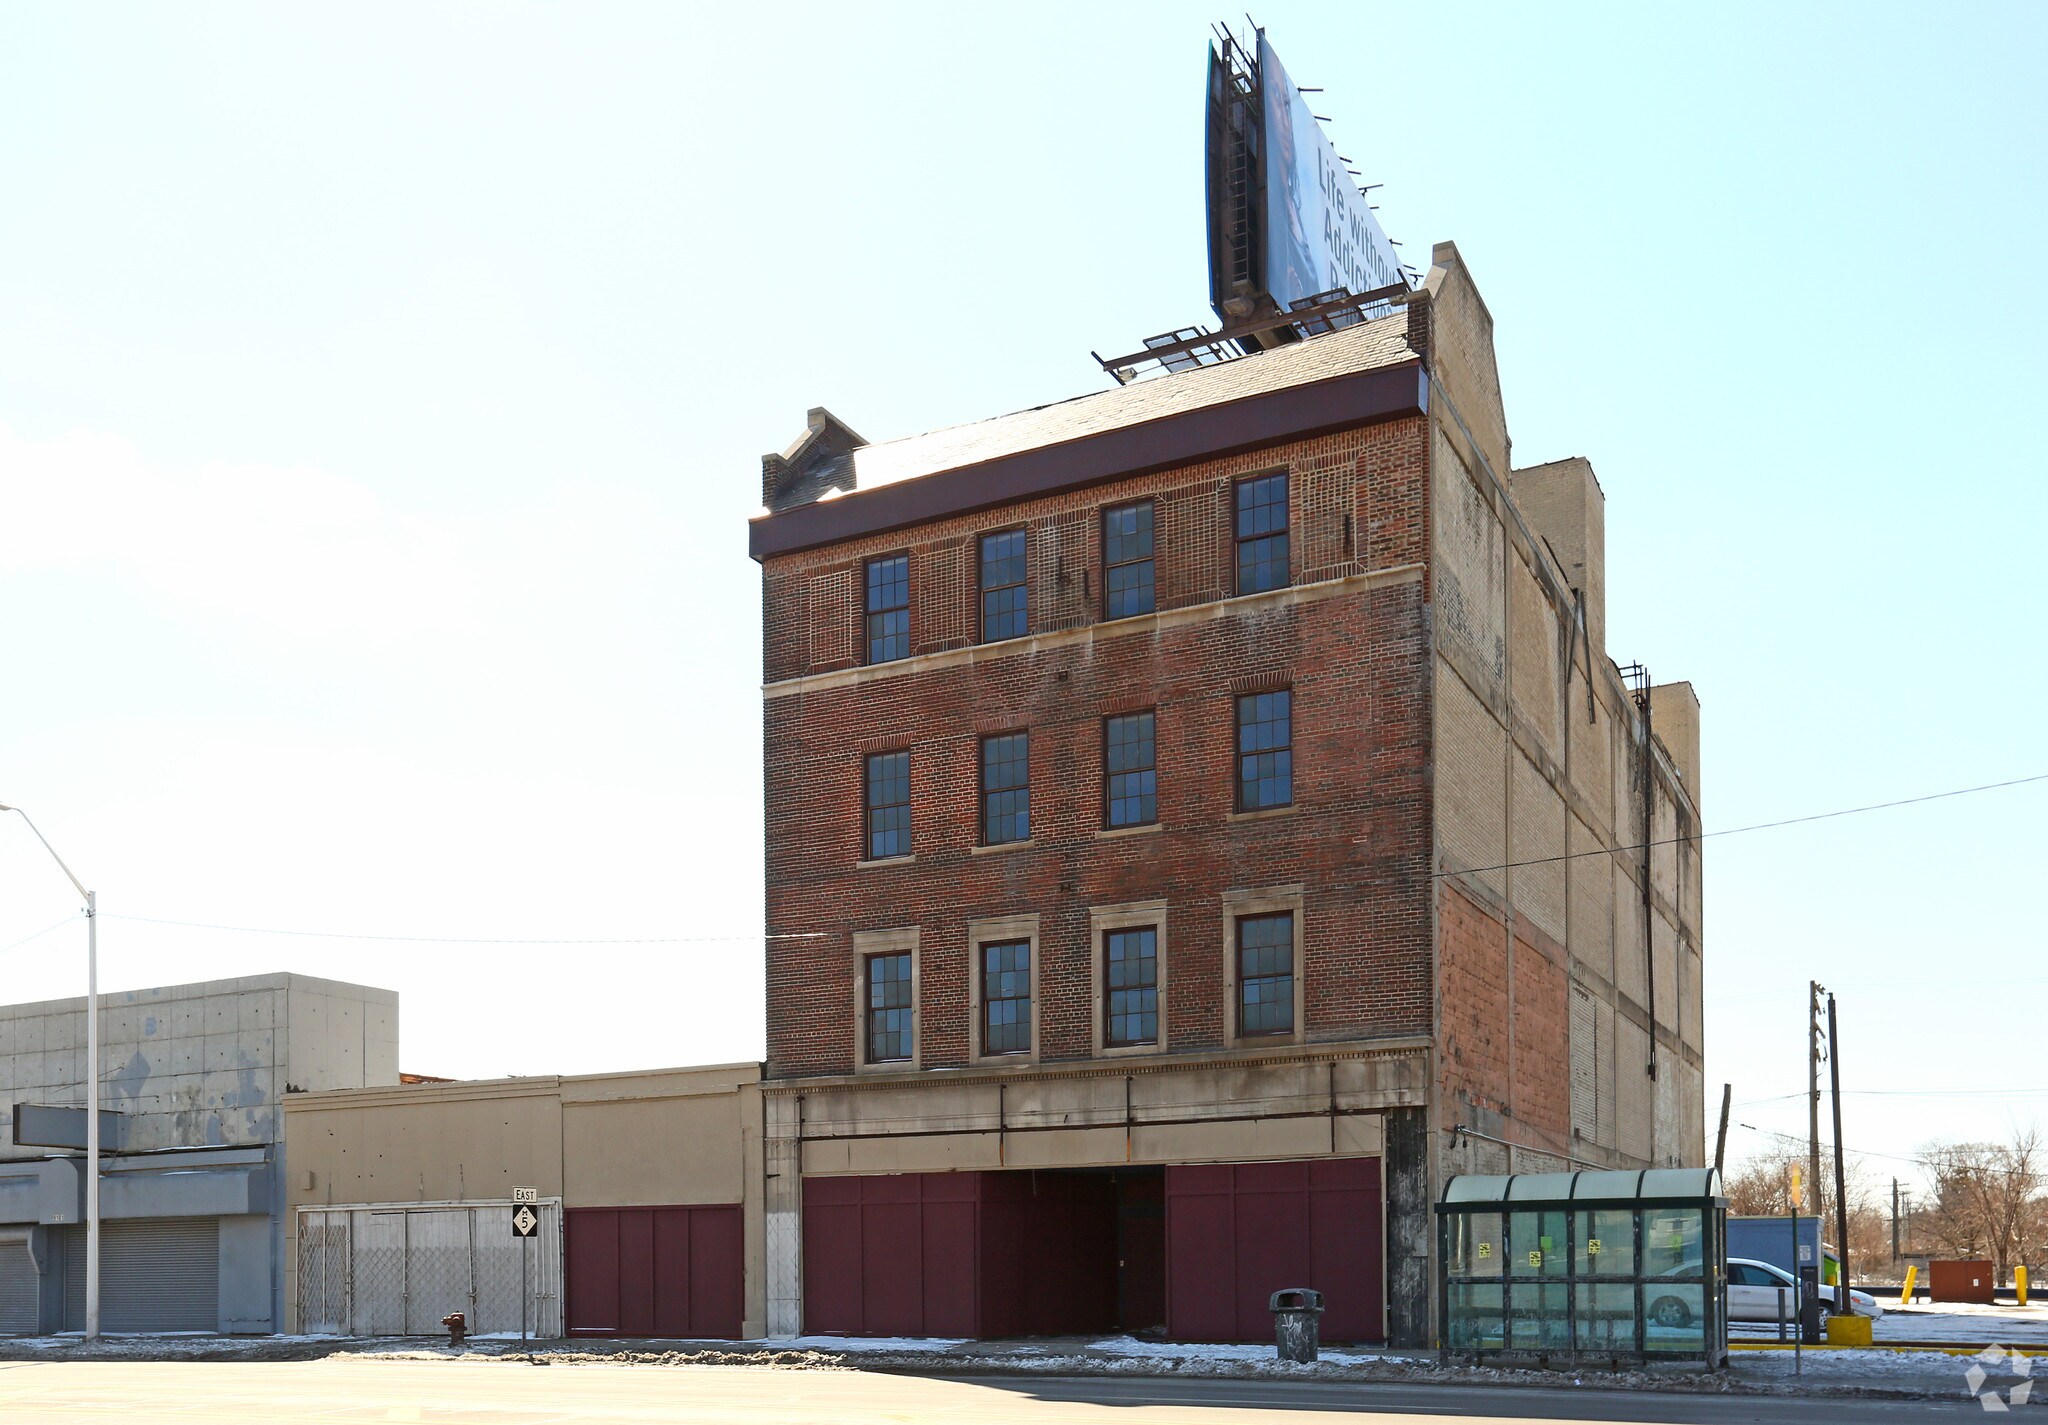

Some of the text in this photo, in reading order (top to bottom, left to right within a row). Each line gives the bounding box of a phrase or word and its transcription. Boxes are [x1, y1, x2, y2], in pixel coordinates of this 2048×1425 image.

[1318, 146, 1345, 221] Life
[516, 1190, 534, 1200] EAST
[522, 1217, 528, 1228] 5
